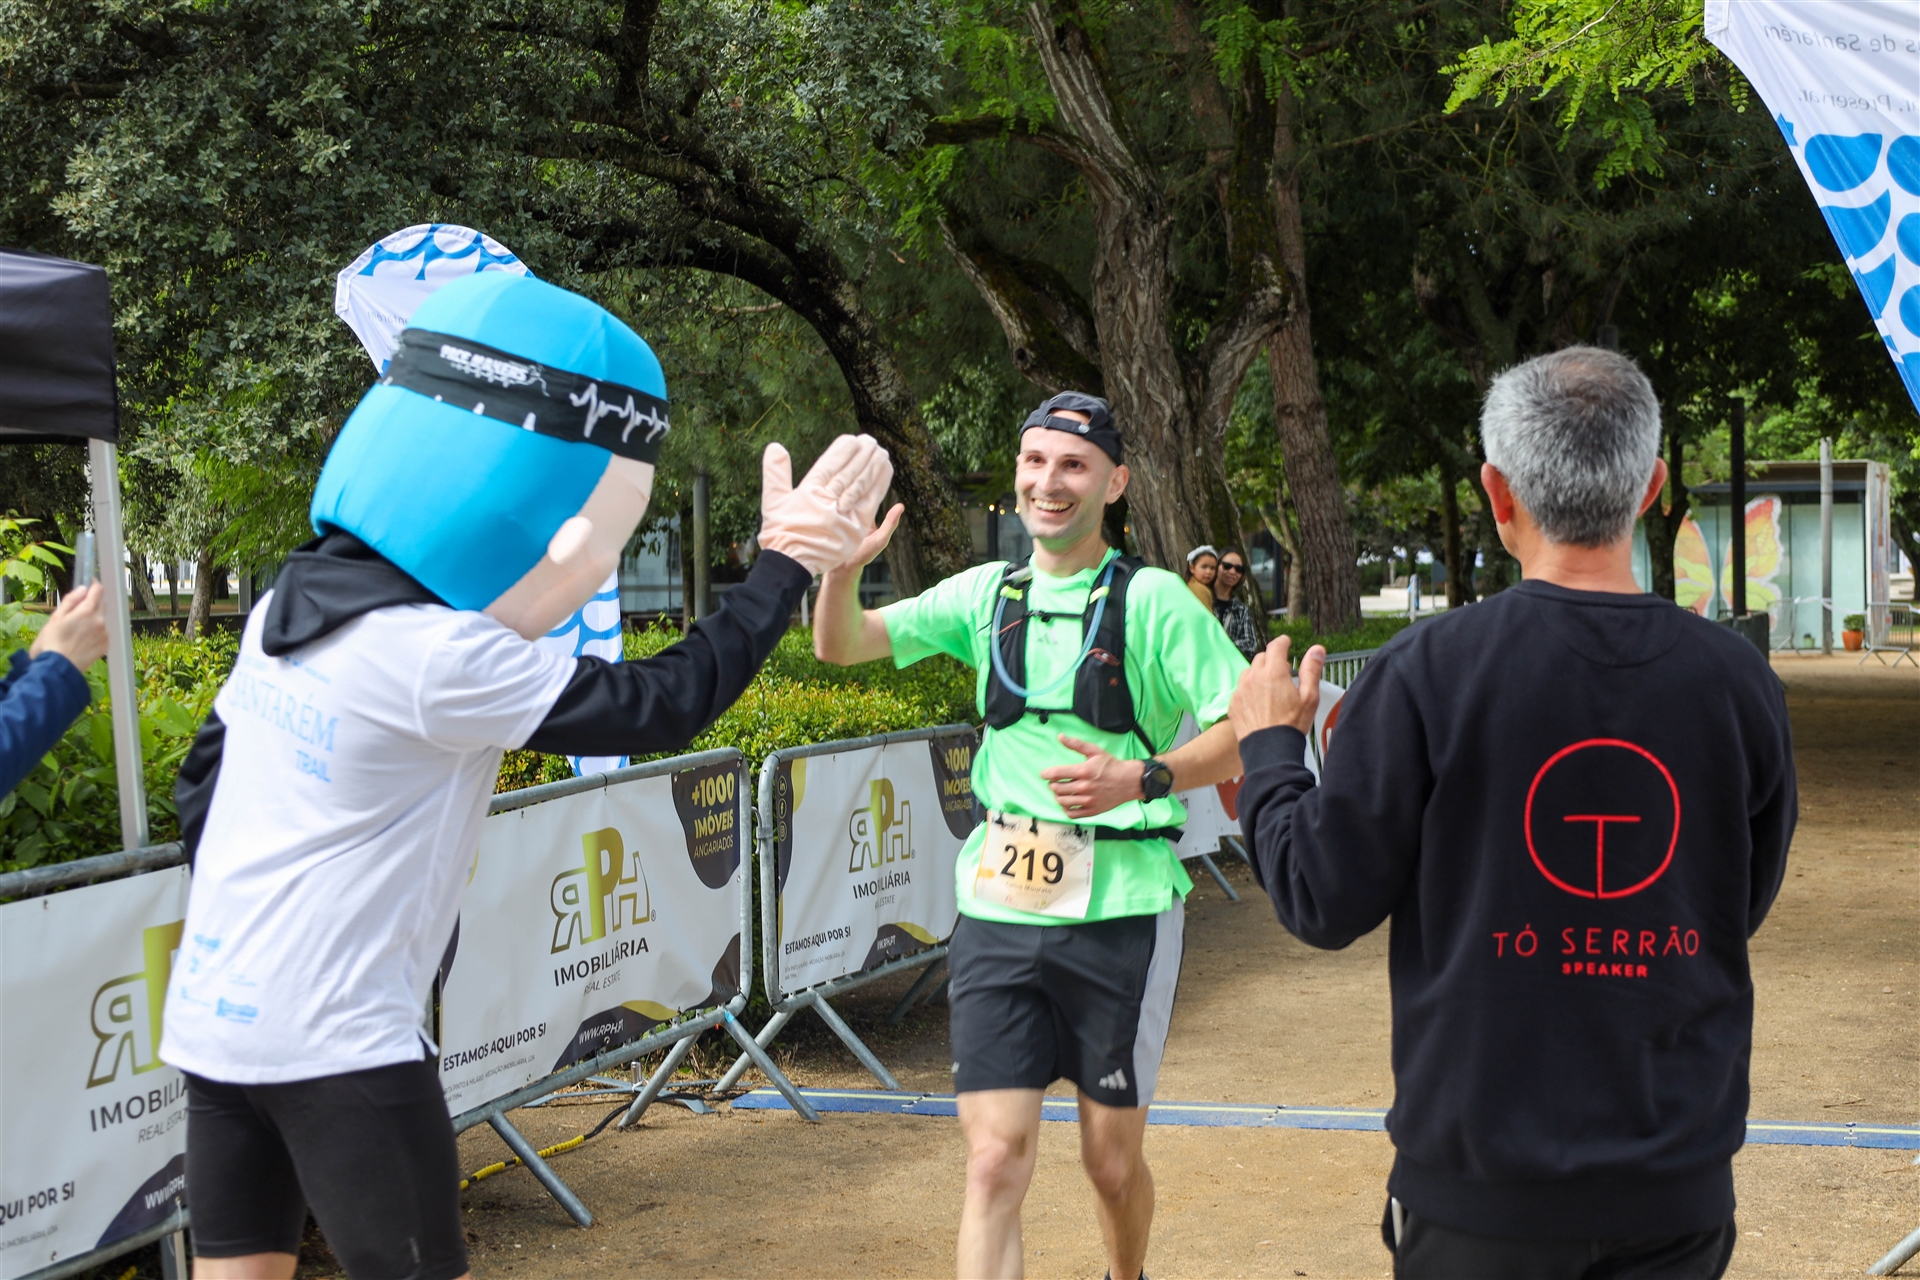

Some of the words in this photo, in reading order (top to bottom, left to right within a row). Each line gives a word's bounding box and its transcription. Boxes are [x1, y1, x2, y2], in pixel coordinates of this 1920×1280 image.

[691, 771, 735, 808] +1000
[694, 808, 734, 840] IMÓVEIS
[693, 834, 734, 860] ANGARIADOS
[1000, 844, 1064, 885] 219
[828, 927, 843, 942] POR
[1492, 923, 1539, 958] TÓ
[1561, 925, 1700, 957] SERRÃO
[553, 937, 650, 988] IMOBILIÁRIA
[1561, 961, 1648, 978] SPEAKER
[443, 1042, 489, 1073] ESTAMOS
[489, 1033, 515, 1054] AQUI
[516, 1026, 537, 1046] POR
[537, 1021, 547, 1038] SI
[137, 1124, 166, 1144] REAL
[28, 1187, 58, 1215] POR
[62, 1180, 76, 1201] SI
